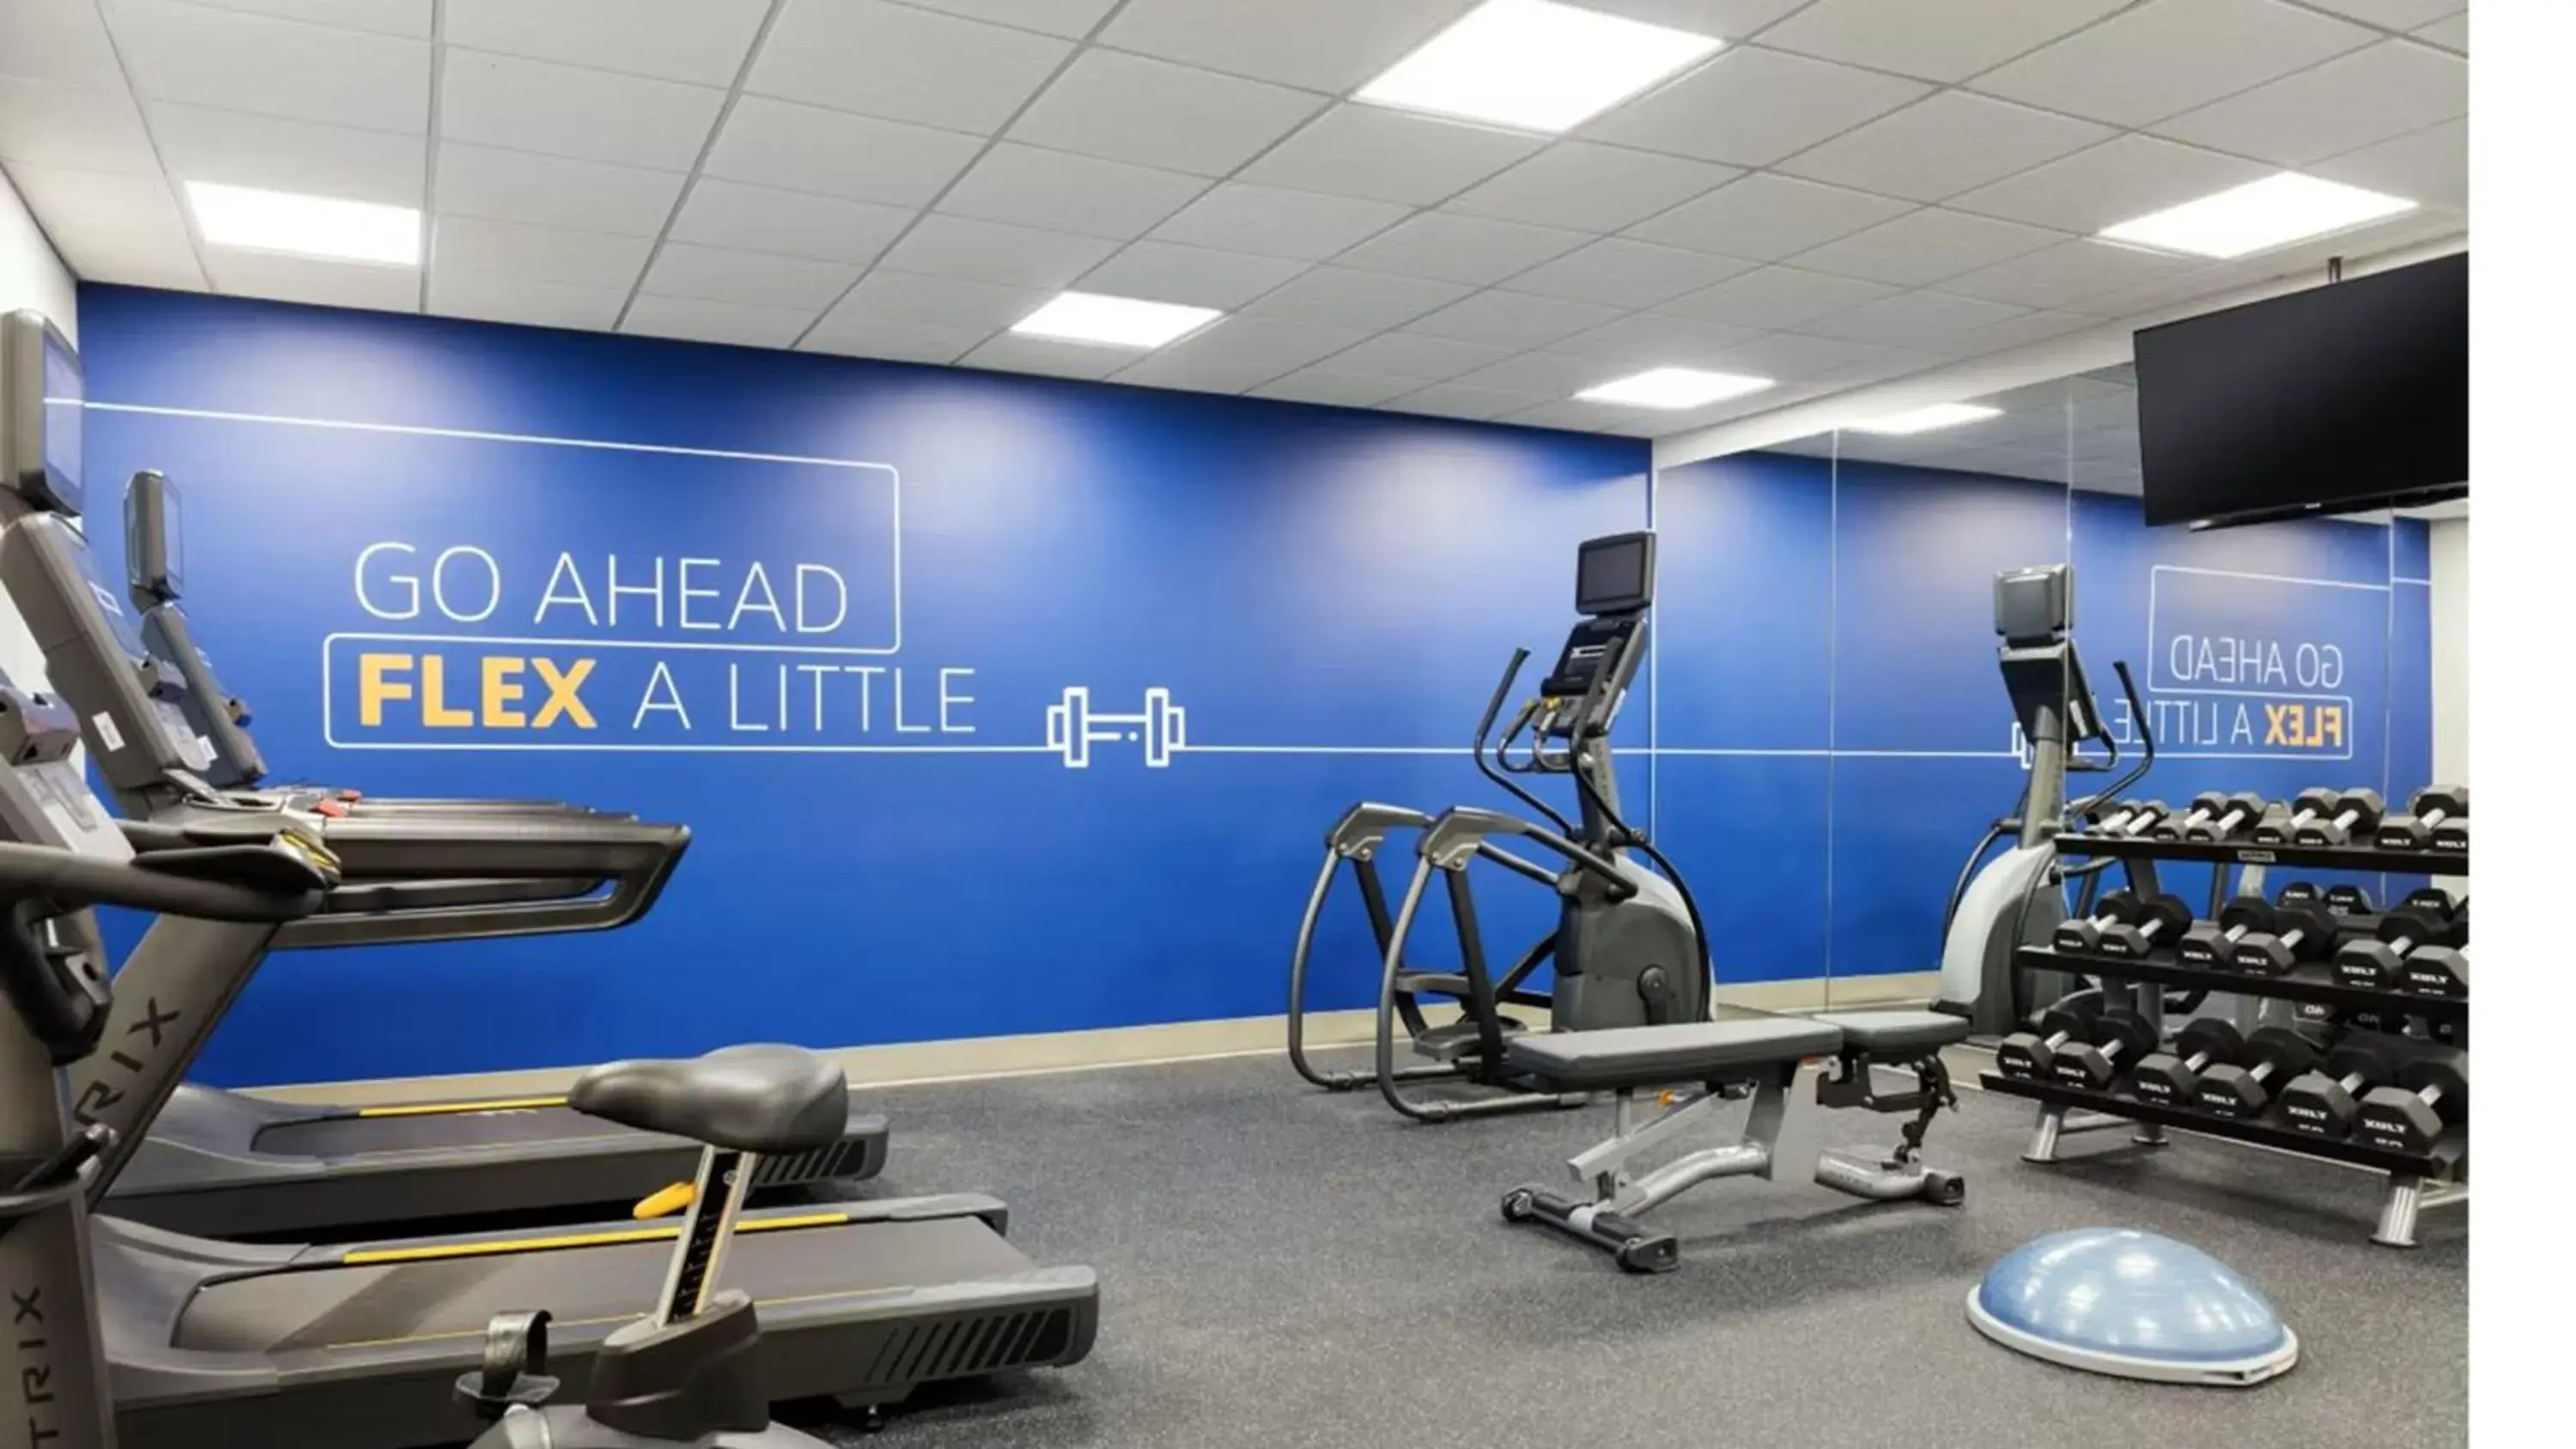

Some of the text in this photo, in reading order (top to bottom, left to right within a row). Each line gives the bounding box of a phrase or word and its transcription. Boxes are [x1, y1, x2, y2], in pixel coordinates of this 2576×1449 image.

[355, 542, 848, 634] GO AHEAD
[359, 652, 977, 734] FLEX A LITTLE
